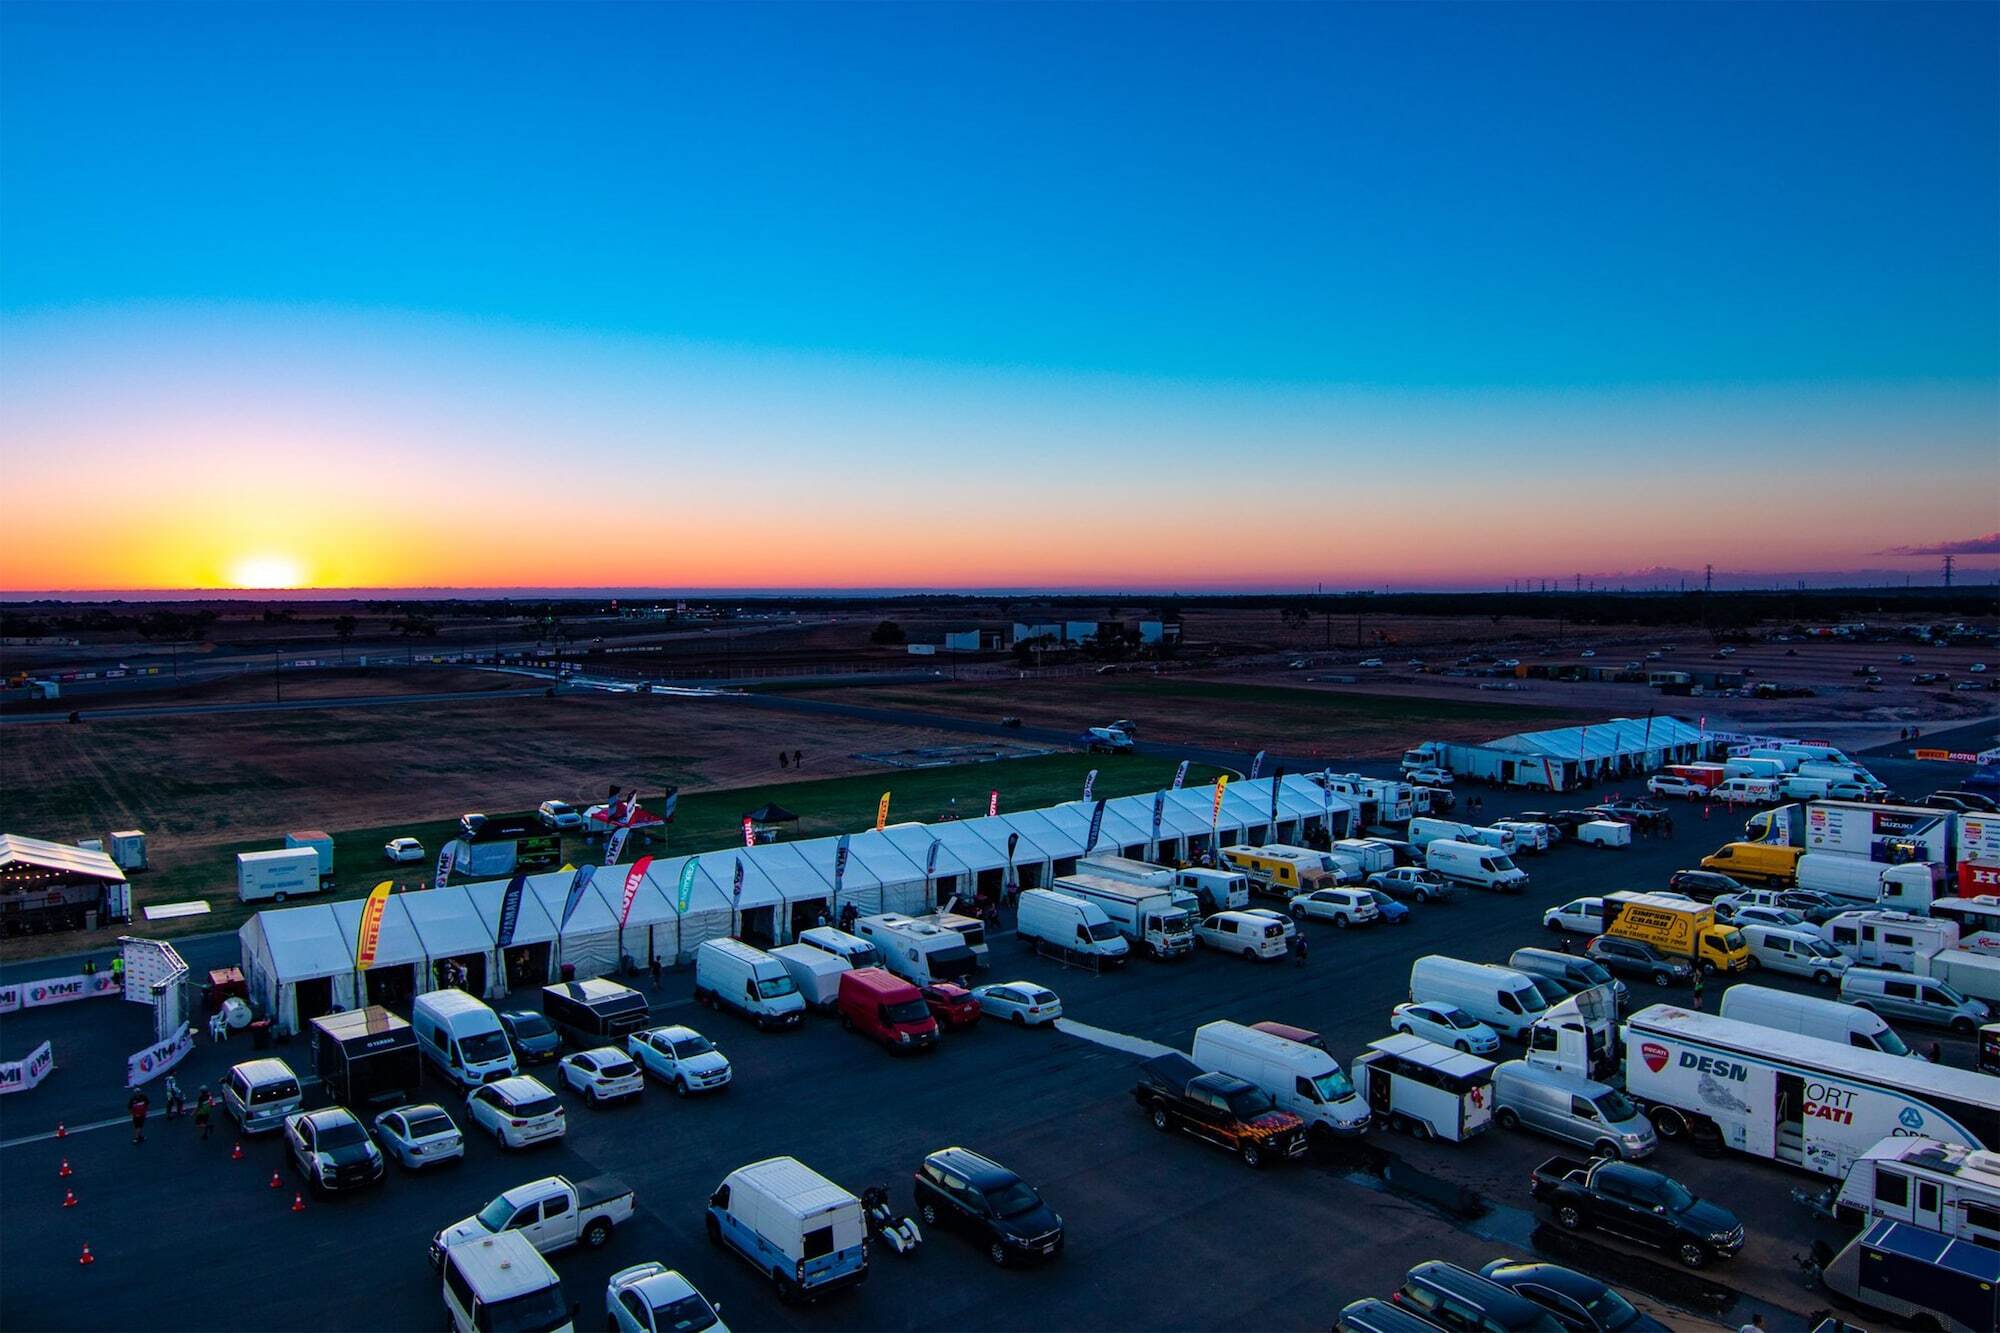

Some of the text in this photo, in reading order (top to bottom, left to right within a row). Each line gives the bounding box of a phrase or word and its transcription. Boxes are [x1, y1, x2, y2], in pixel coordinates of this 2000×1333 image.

[989, 794, 998, 816] OTUL
[1880, 821, 1913, 829] SUZUKI
[743, 822, 754, 847] OTUL
[607, 837, 620, 859] YMF
[439, 853, 449, 877] YMF
[1973, 870, 2000, 884] H
[1631, 909, 1673, 921] SIMPSON
[360, 897, 385, 960] PIRELLI
[48, 982, 82, 994] YMF
[1643, 1046, 1667, 1056] DUCATI
